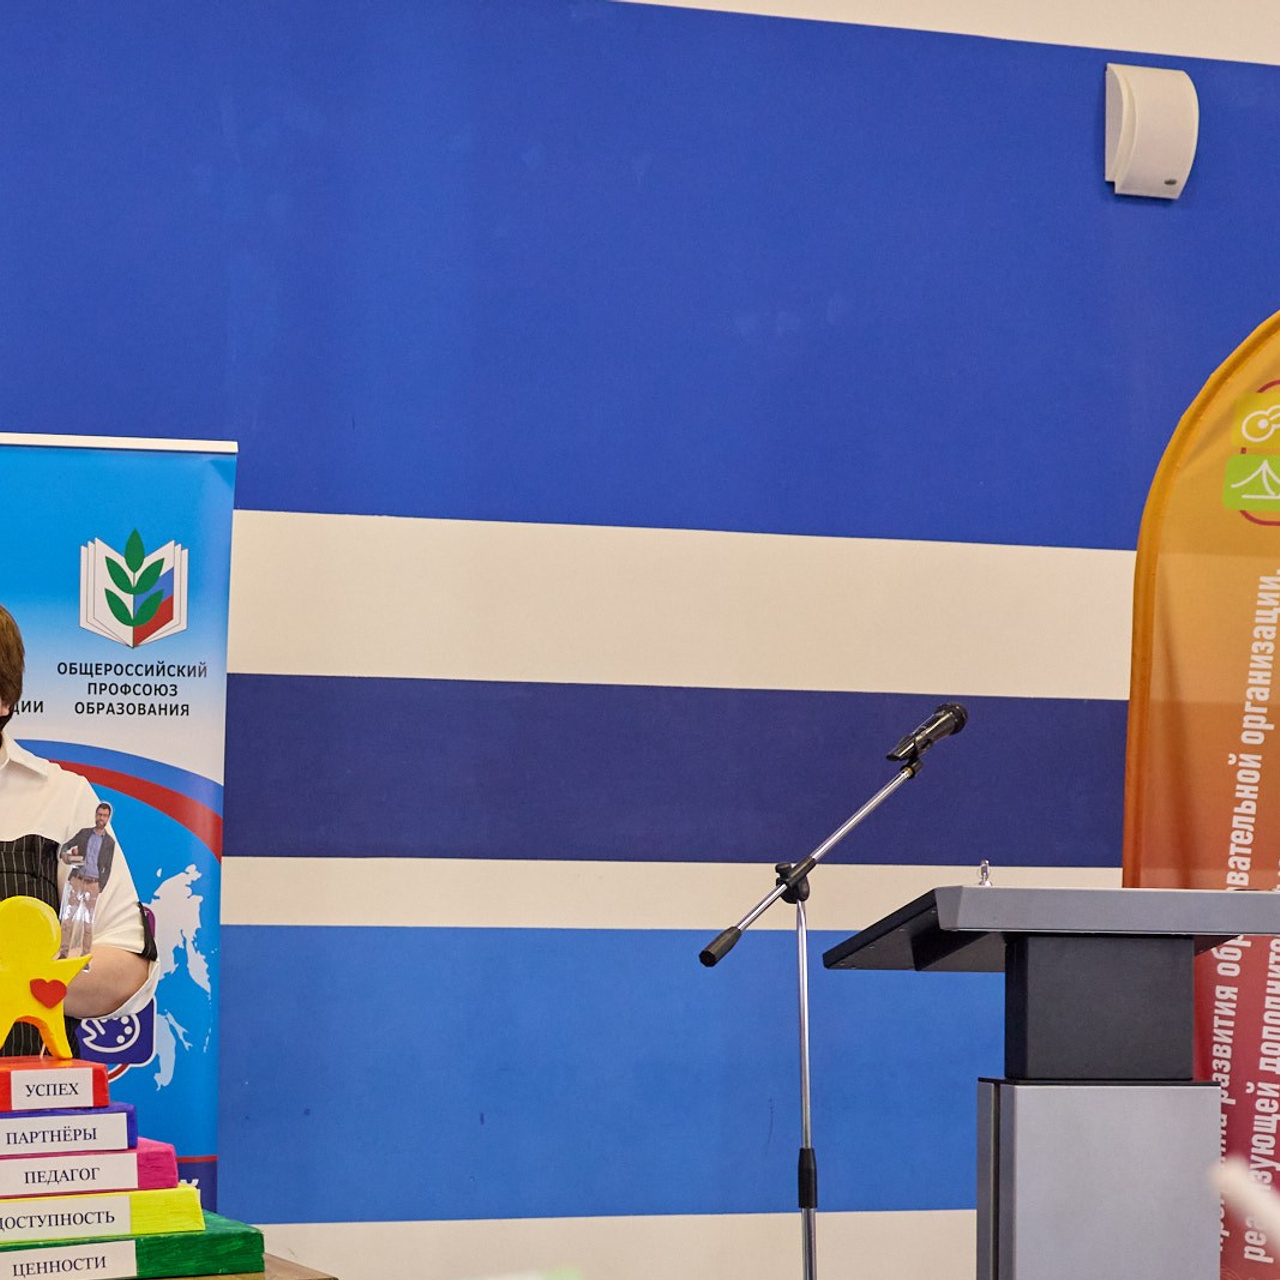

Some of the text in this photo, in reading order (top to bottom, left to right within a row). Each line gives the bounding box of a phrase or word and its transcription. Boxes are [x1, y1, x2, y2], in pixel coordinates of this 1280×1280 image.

[57, 661, 207, 678] ОБЩЕРОССИЙСКИЙ
[87, 682, 178, 696] ПРОФСОЮЗ
[74, 701, 189, 716] ОБРАЗОВАНИЯ
[25, 1082, 79, 1097] УСПЕХ
[6, 1126, 97, 1145] ПАРТНЁРЫ
[24, 1167, 100, 1185] ПЕДАГОГ
[12, 1256, 107, 1278] ЦЕННОСТИ
